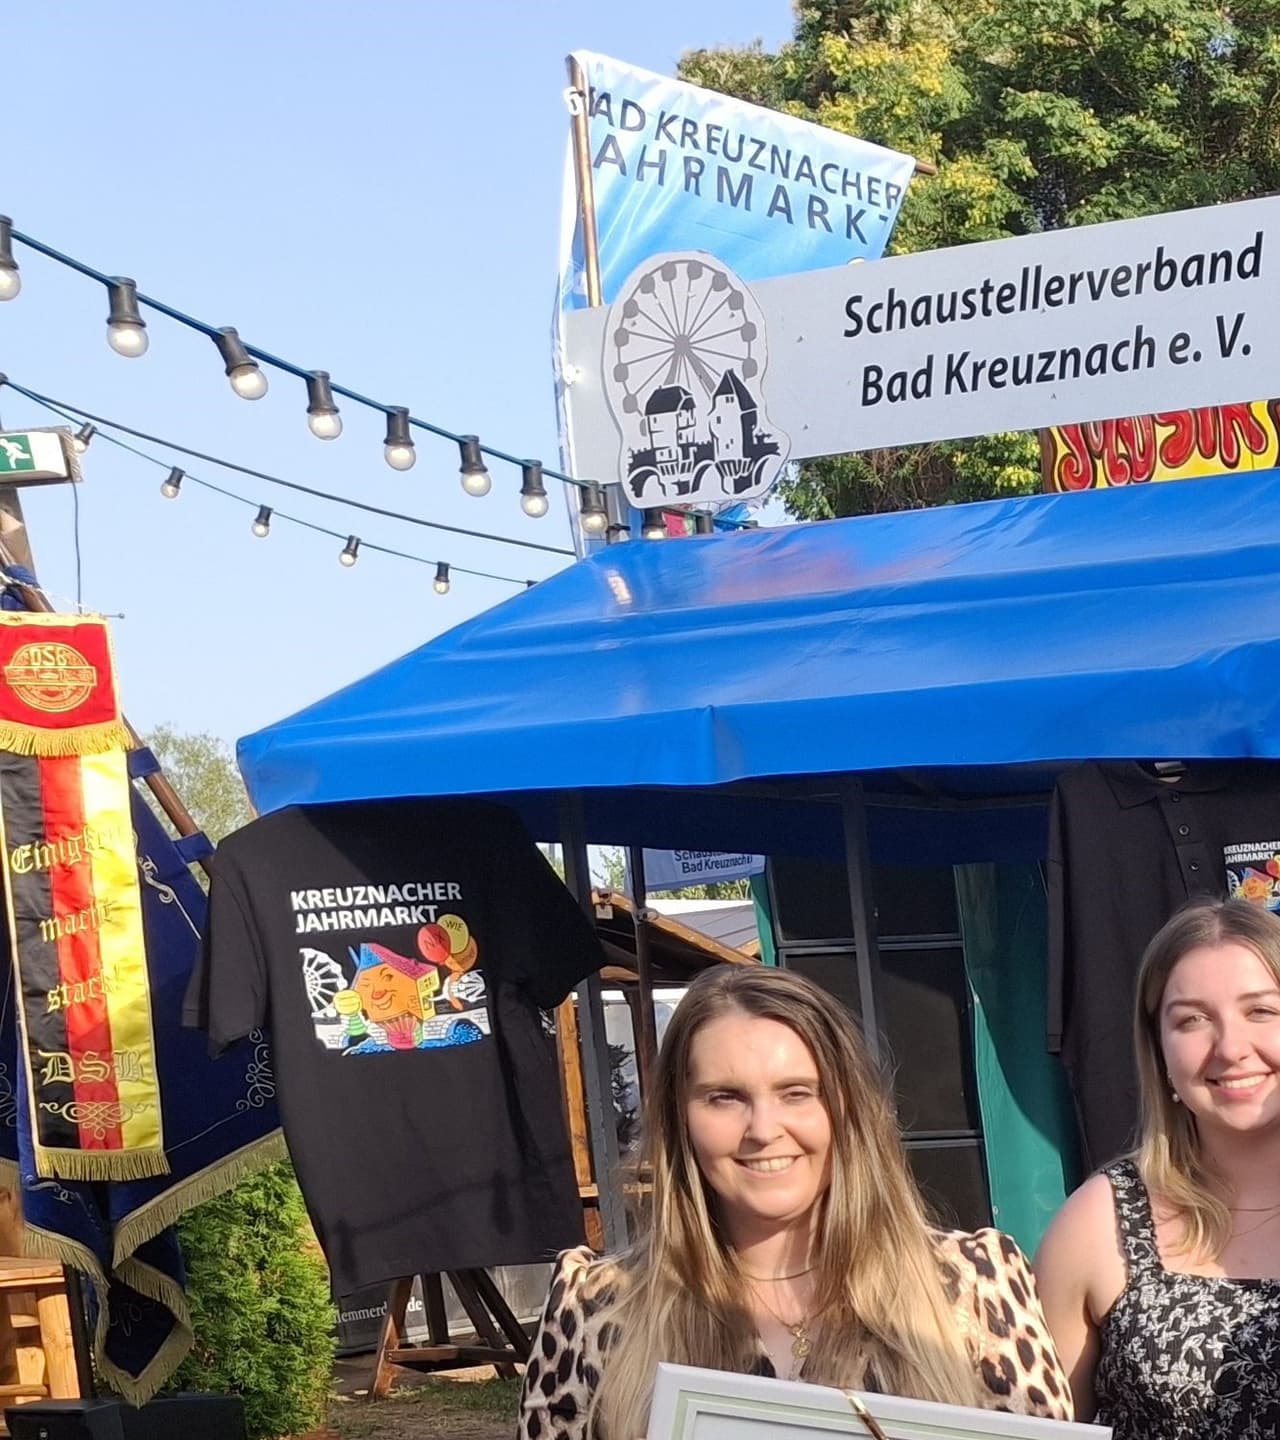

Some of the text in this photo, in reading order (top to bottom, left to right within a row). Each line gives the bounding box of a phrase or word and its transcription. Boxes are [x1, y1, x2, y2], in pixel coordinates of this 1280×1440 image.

[656, 110, 902, 210] KREUZNACHER
[592, 133, 889, 246] AHRMARK
[843, 231, 1264, 338] Schaustellerverband
[861, 350, 932, 407] Bad
[944, 323, 1157, 396] Kreuznach
[682, 859, 702, 873] Bad
[1225, 851, 1275, 864] JAHRMARKT
[290, 882, 462, 911] KREUZNACHER
[295, 905, 438, 933] JAHRMARKT
